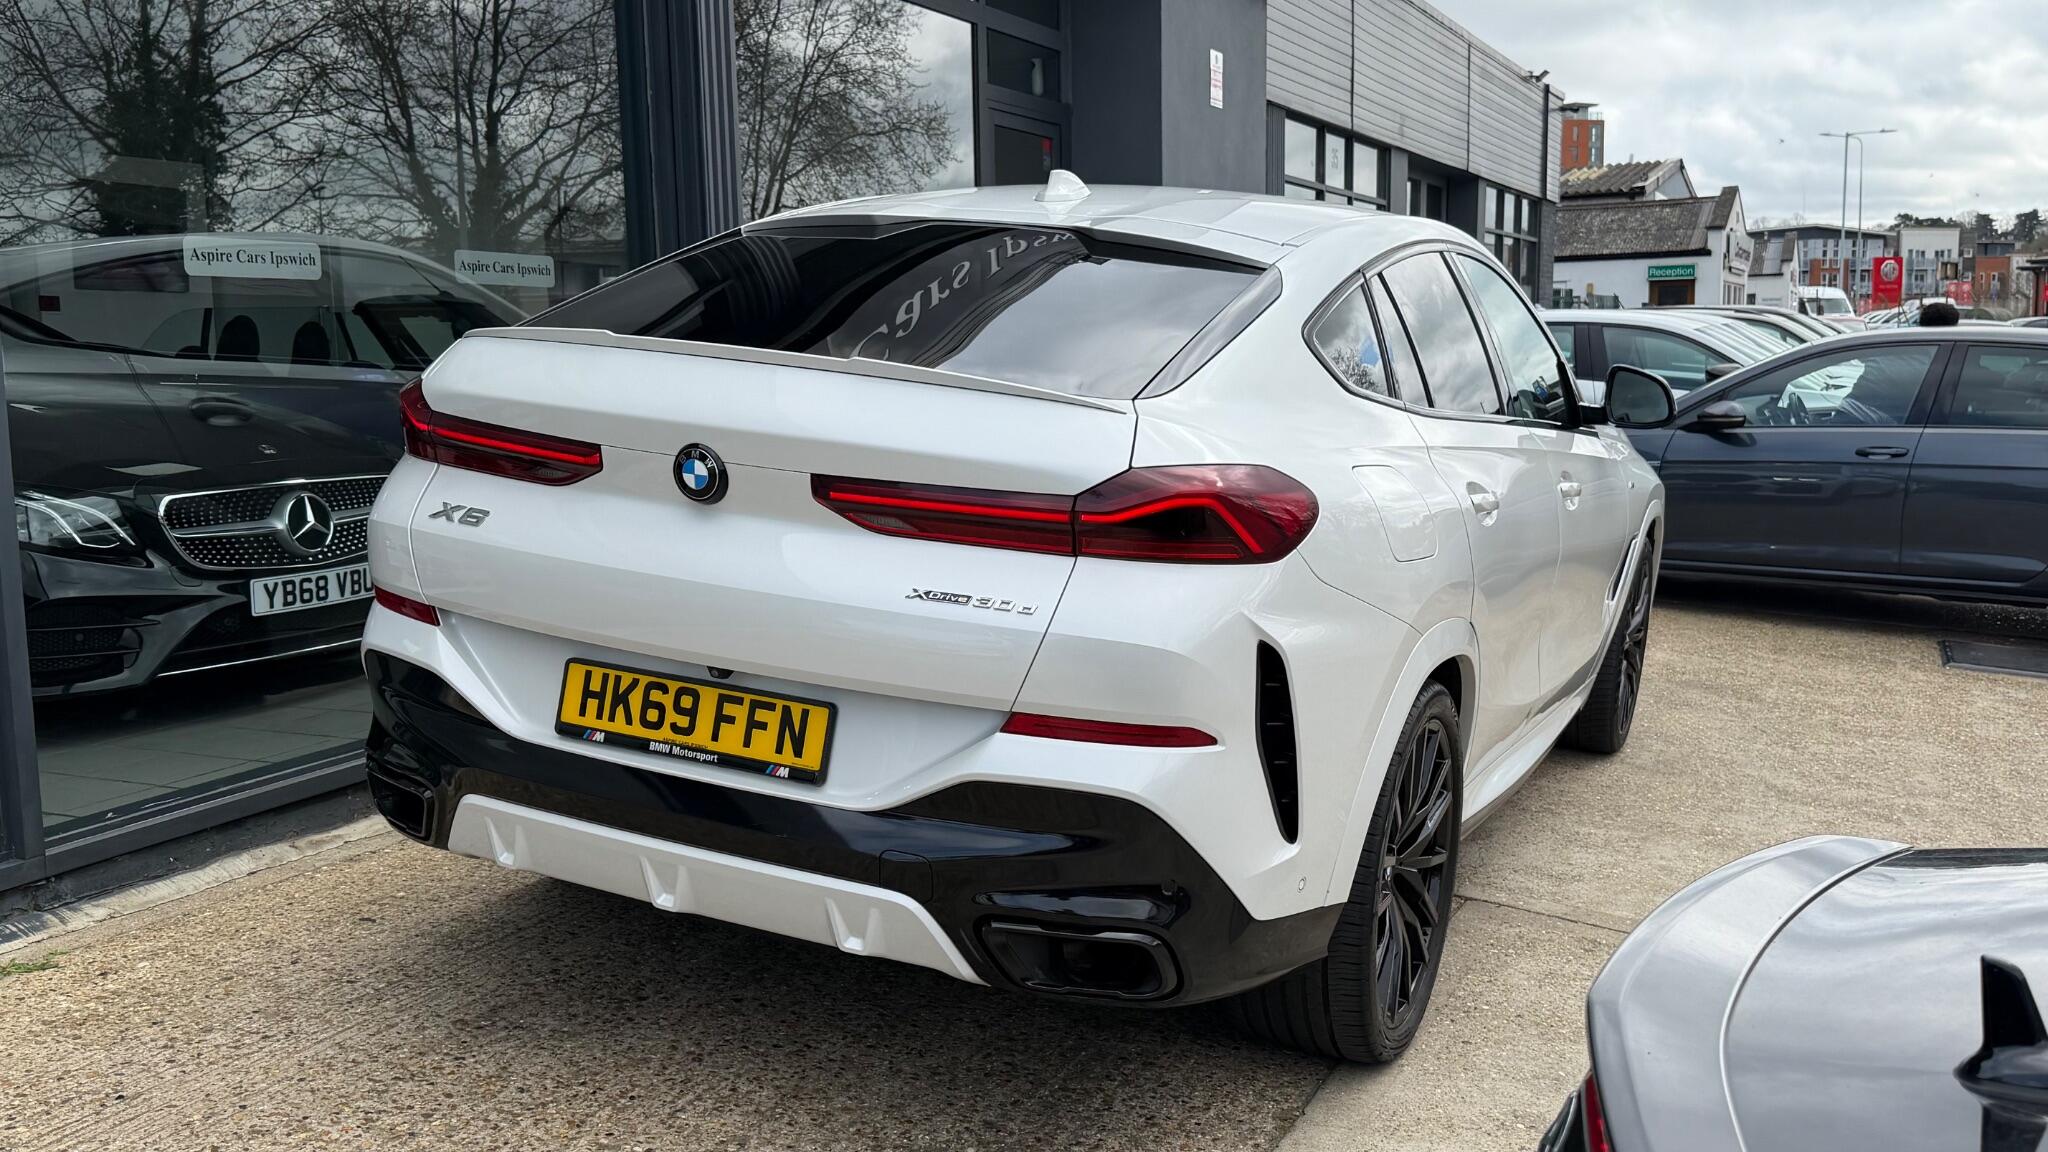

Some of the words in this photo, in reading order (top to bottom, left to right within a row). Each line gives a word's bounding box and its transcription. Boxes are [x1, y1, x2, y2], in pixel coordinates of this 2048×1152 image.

[189, 247, 233, 266] Aspire
[236, 249, 267, 264] Cars
[270, 251, 316, 268] Ipswich
[459, 260, 491, 275] Aspire
[492, 261, 515, 274] Cars
[517, 262, 551, 278] Ipswich
[1649, 266, 1694, 277] Reception
[679, 449, 715, 469] BMW
[428, 501, 490, 527] X6
[263, 575, 329, 609] YB68
[578, 670, 700, 737] HK69
[710, 692, 810, 760] FFN
[649, 741, 671, 754] BMW
[672, 745, 719, 763] Motorsport
